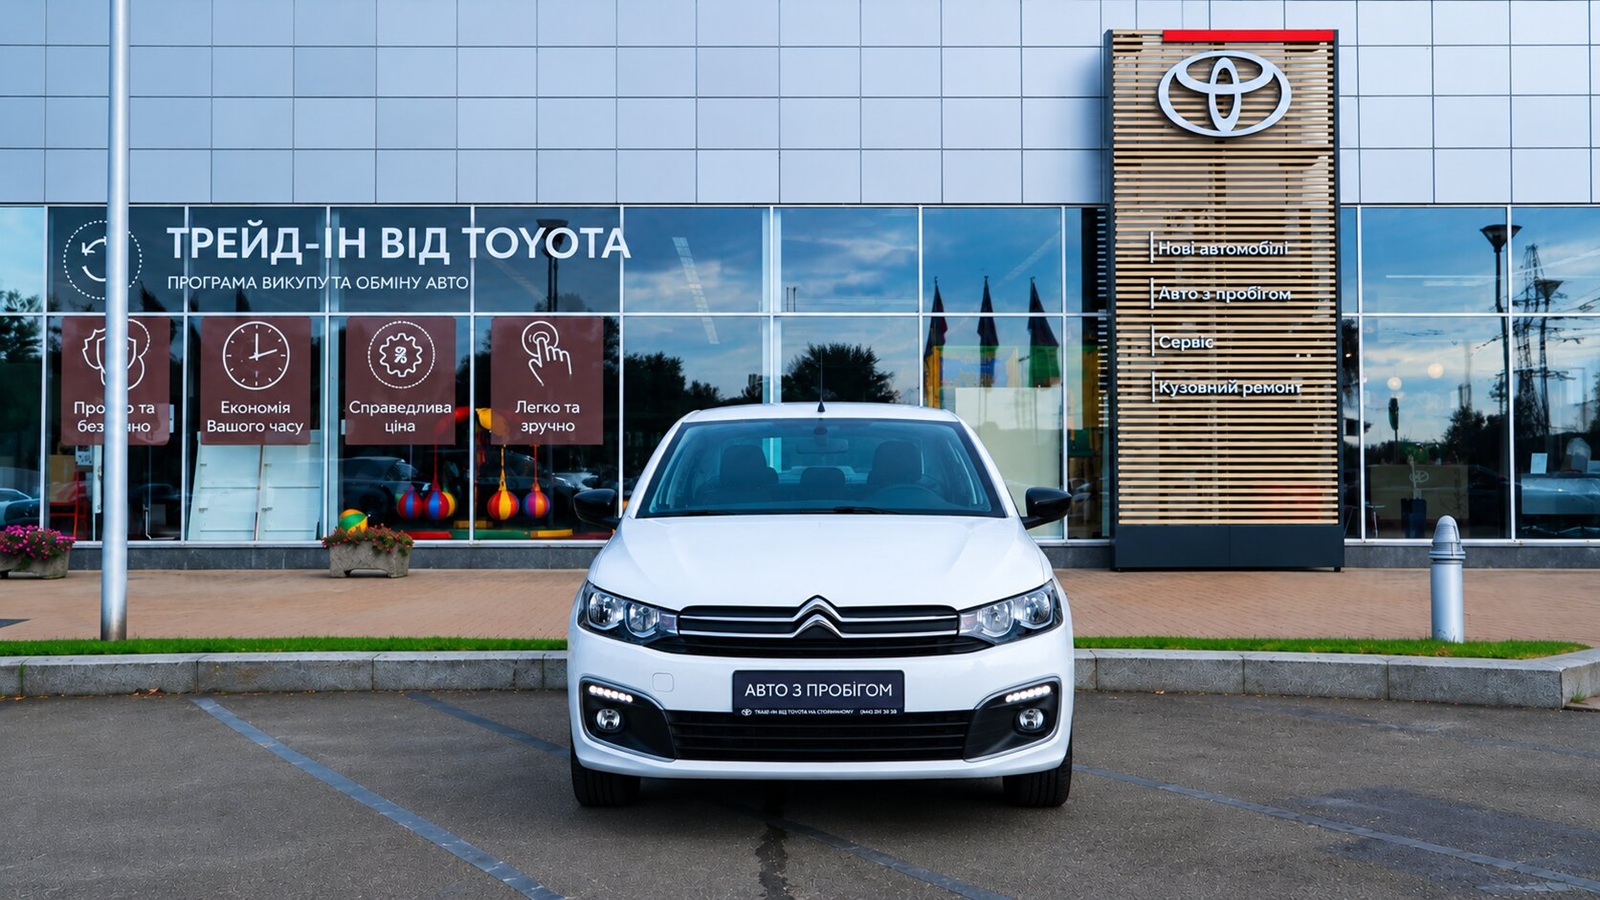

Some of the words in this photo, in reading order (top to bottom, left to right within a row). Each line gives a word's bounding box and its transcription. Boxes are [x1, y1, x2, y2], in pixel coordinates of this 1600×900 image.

[166, 219, 366, 265] ТРЕЙД-ІН
[381, 227, 451, 265] ВІД
[461, 227, 632, 259] TOYOTA
[1158, 241, 1195, 255] Нові
[1199, 241, 1289, 255] автомобілі
[167, 276, 257, 290] ПРОГРАМА
[262, 276, 329, 290] ВИКУПУ
[331, 276, 352, 290] ТА
[356, 276, 422, 290] ОБМІНУ
[425, 276, 469, 290] АВТО
[1158, 286, 1198, 300] Авто
[1202, 290, 1211, 300] з
[1216, 286, 1292, 303] пробігом
[1159, 335, 1214, 351] Сервіс
[1159, 379, 1239, 397] Кузовний
[1243, 382, 1303, 397] ремонт
[73, 401, 134, 417] Проо
[138, 404, 155, 414] та
[221, 401, 291, 414] Економія
[349, 401, 452, 416] Справедлива
[515, 401, 561, 414] Легко
[564, 404, 580, 414] та
[77, 420, 151, 433] безно
[206, 420, 265, 433] Вашого
[269, 422, 304, 435] часу
[385, 420, 416, 433] ціна
[521, 422, 576, 435] зручно
[744, 684, 788, 697] АВТО
